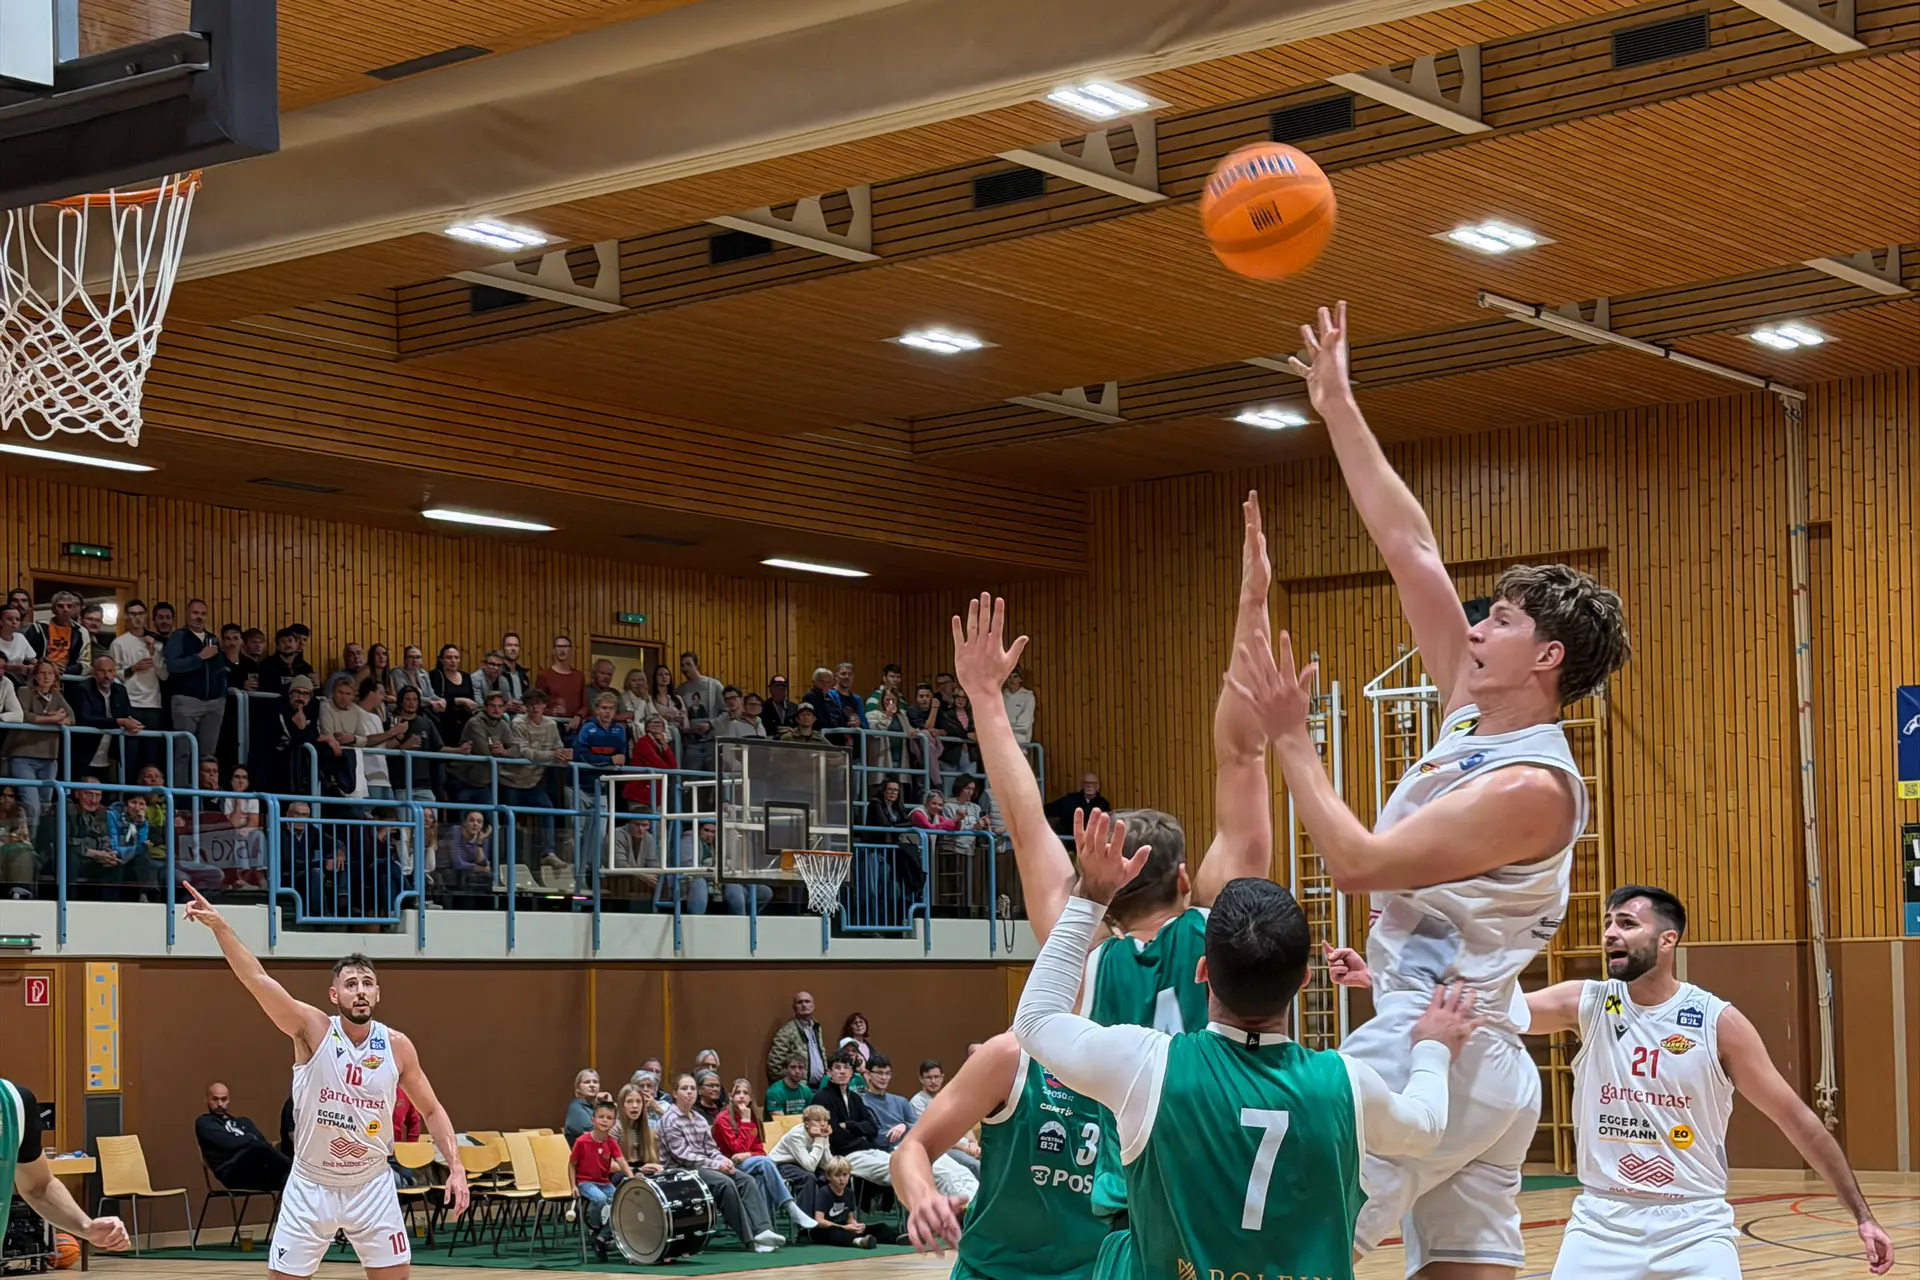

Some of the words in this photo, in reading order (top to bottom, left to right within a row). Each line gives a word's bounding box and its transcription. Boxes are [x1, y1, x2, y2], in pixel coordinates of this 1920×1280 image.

[345, 1062, 363, 1086] 10
[1631, 1046, 1660, 1079] 21
[1599, 1082, 1692, 1109] gartenrast
[317, 1109, 346, 1121] EGGER
[1599, 1114, 1638, 1127] EGGER
[1641, 1118, 1650, 1128] &
[1075, 1122, 1100, 1166] 3
[1598, 1126, 1657, 1140] OTTMANN
[1673, 1129, 1689, 1139] EO
[1040, 1140, 1060, 1151] B2L
[1240, 1107, 1290, 1231] 7
[388, 1231, 407, 1255] 10
